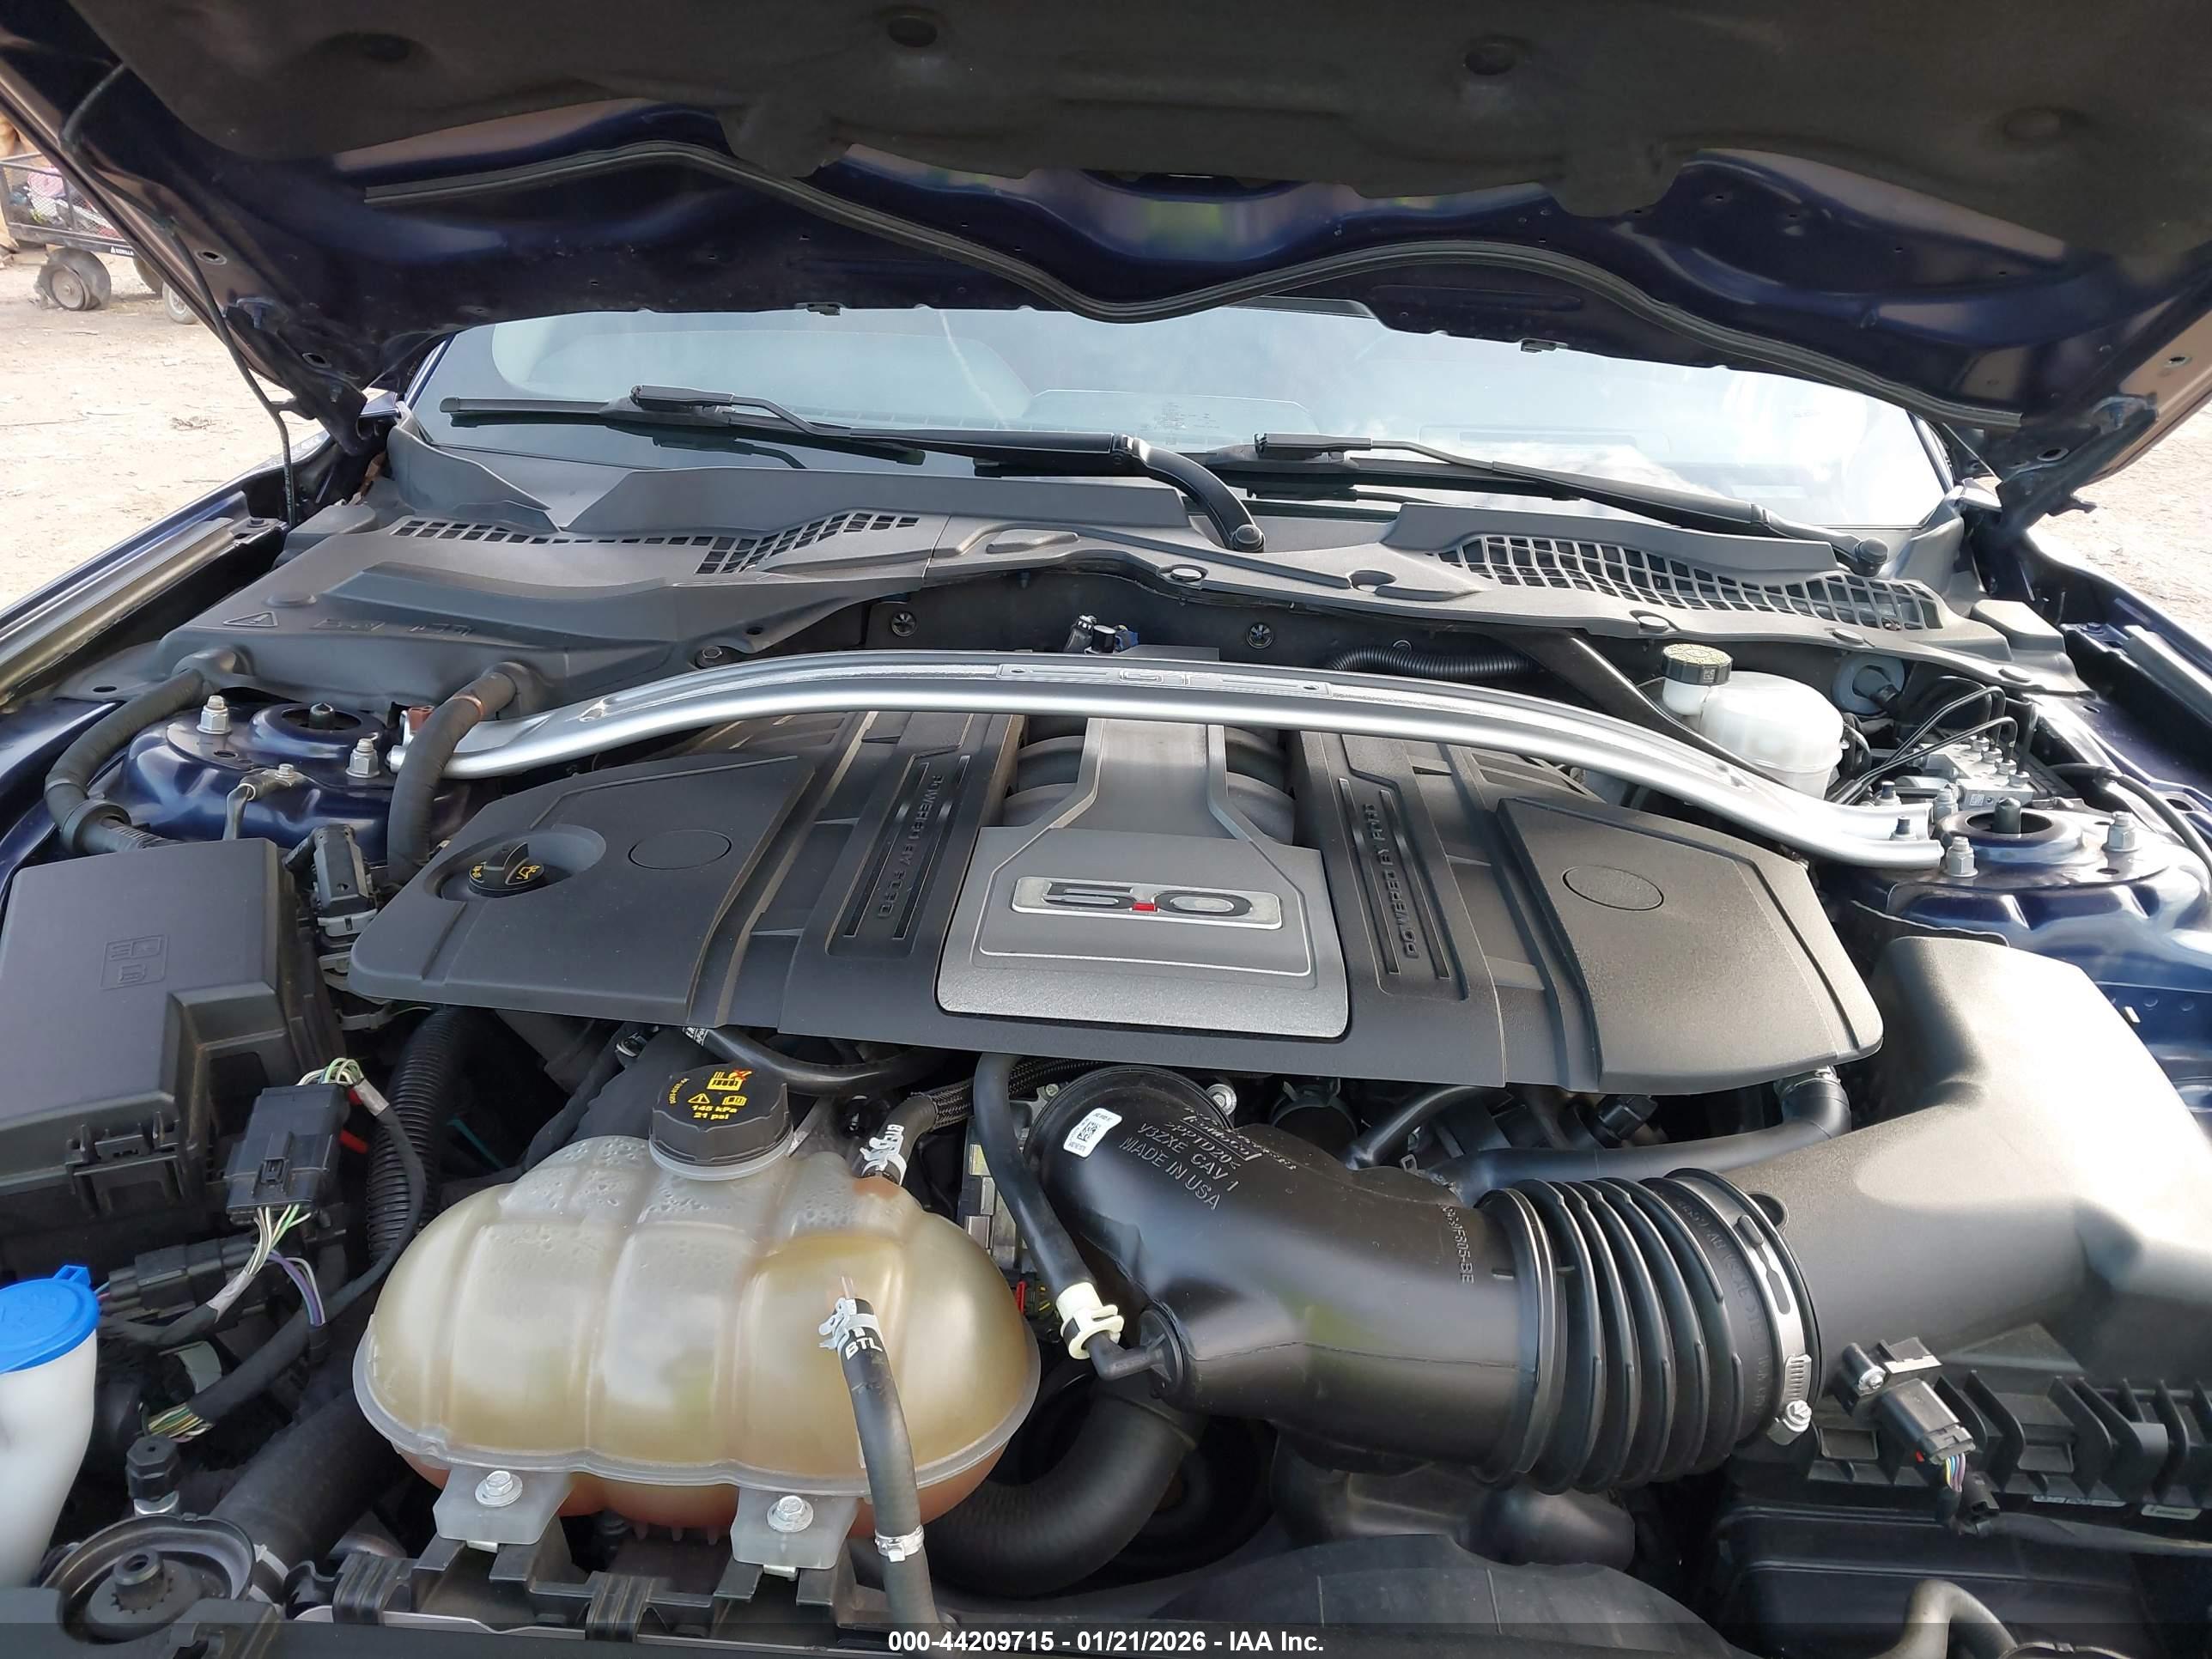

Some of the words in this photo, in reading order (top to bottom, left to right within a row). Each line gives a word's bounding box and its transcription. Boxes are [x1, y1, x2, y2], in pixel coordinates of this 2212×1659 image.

[1042, 881, 1254, 917] 5.0
[714, 1105, 738, 1114] kPa
[1118, 1136, 1169, 1168] MADE
[1164, 1161, 1188, 1181] IN
[1184, 1174, 1221, 1211] USA
[1190, 1153, 1229, 1180] CAV
[845, 1336, 884, 1360] BTL
